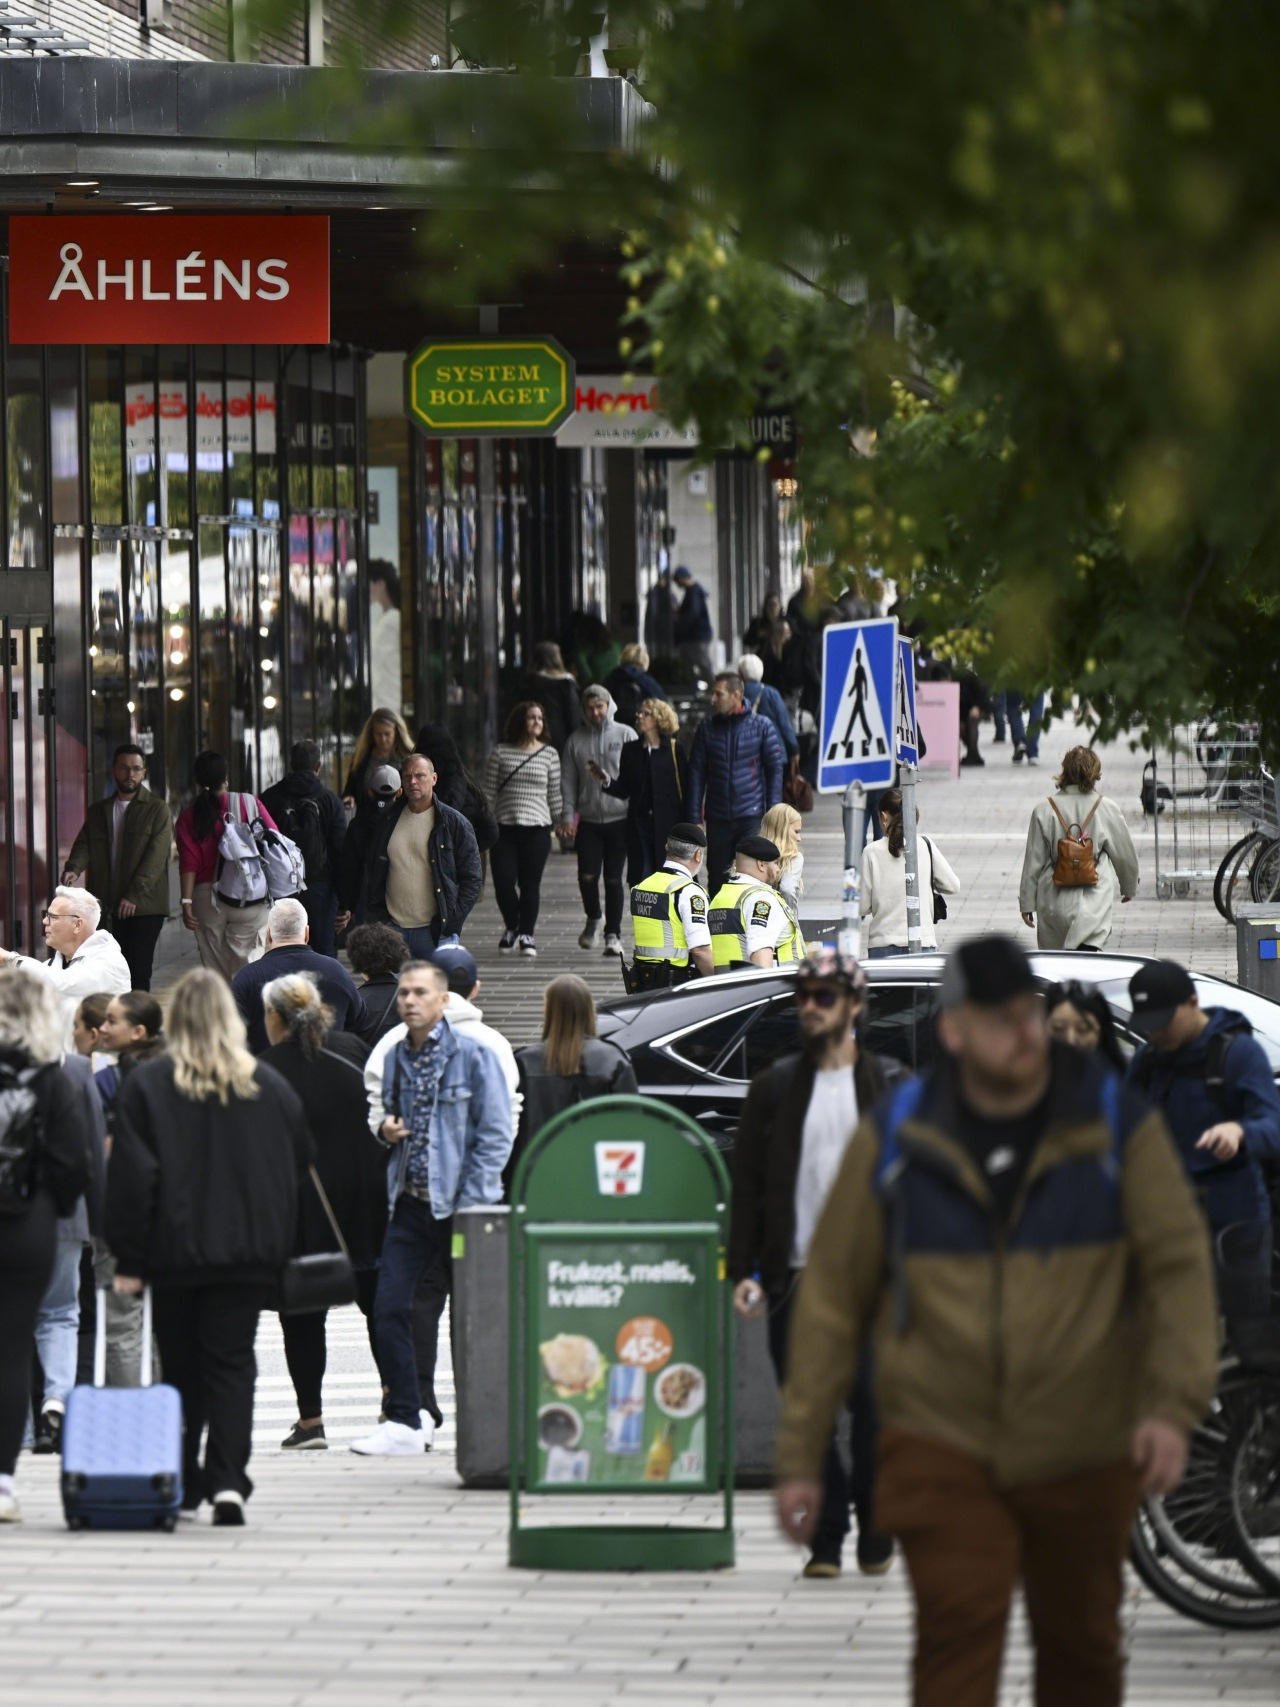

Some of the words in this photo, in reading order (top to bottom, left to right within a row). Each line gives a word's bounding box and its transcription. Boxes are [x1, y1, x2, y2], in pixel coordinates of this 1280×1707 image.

[48, 242, 290, 301] ÅHLÉNS
[436, 365, 541, 383] SYSTEM
[429, 387, 549, 406] BOLAGET
[750, 415, 791, 442] UICE
[635, 891, 659, 905] SKYDDS
[637, 904, 652, 916] VAKT
[548, 1260, 629, 1285] Frukost,
